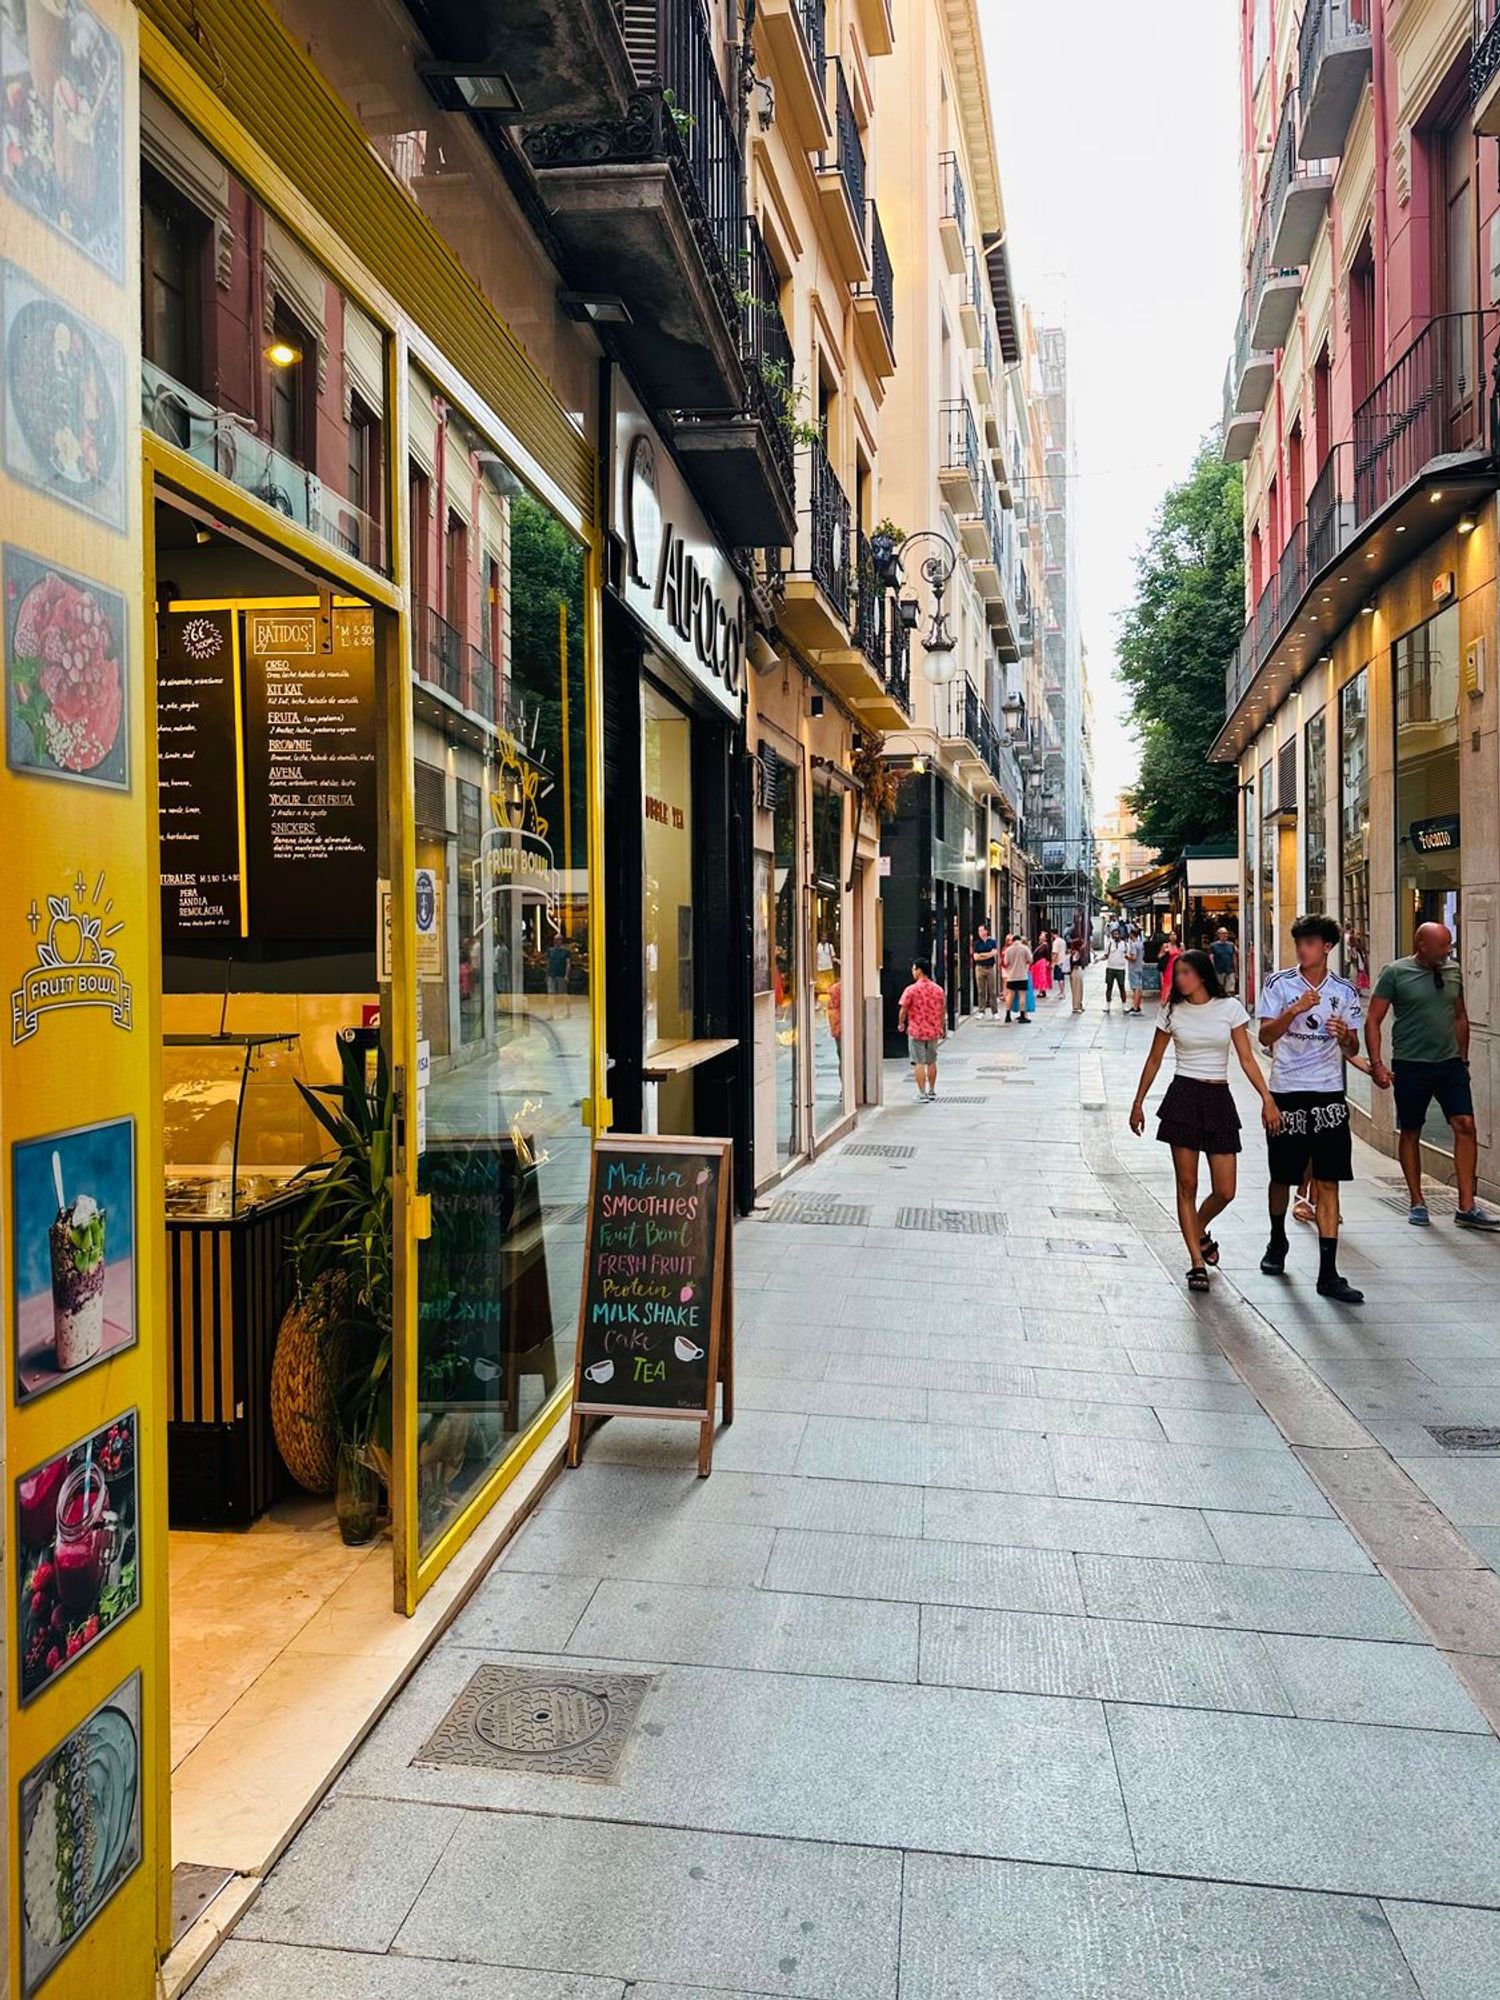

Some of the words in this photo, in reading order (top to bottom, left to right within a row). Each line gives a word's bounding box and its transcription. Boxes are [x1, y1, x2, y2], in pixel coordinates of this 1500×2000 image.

[258, 625, 309, 643] BATIDOS
[265, 660, 290, 670] OREO
[266, 684, 284, 695] KIT
[284, 684, 304, 695] KAT
[268, 711, 300, 723] FRUTA
[268, 740, 312, 750] BROWNIE
[268, 767, 303, 778] AVENA
[269, 794, 301, 805] YOGUR
[307, 795, 327, 805] CON
[327, 795, 355, 805] FRUTA
[271, 822, 316, 833] SNICKERS
[486, 847, 519, 876] FRUIT
[180, 888, 198, 897] PERA
[179, 905, 224, 917] REMOLACHA
[31, 977, 74, 1000] FRUIT
[78, 976, 118, 995] BOWL
[607, 1162, 687, 1192] Matcha
[600, 1221, 640, 1250] Fruit
[645, 1220, 693, 1249] Bowl
[598, 1253, 647, 1277] FRESH
[650, 1253, 696, 1277] FRUIT
[602, 1277, 672, 1301] Protein
[592, 1303, 640, 1326] MILK
[642, 1302, 700, 1328] SHAKE
[604, 1328, 657, 1353] Cake
[633, 1356, 667, 1384] TEA
